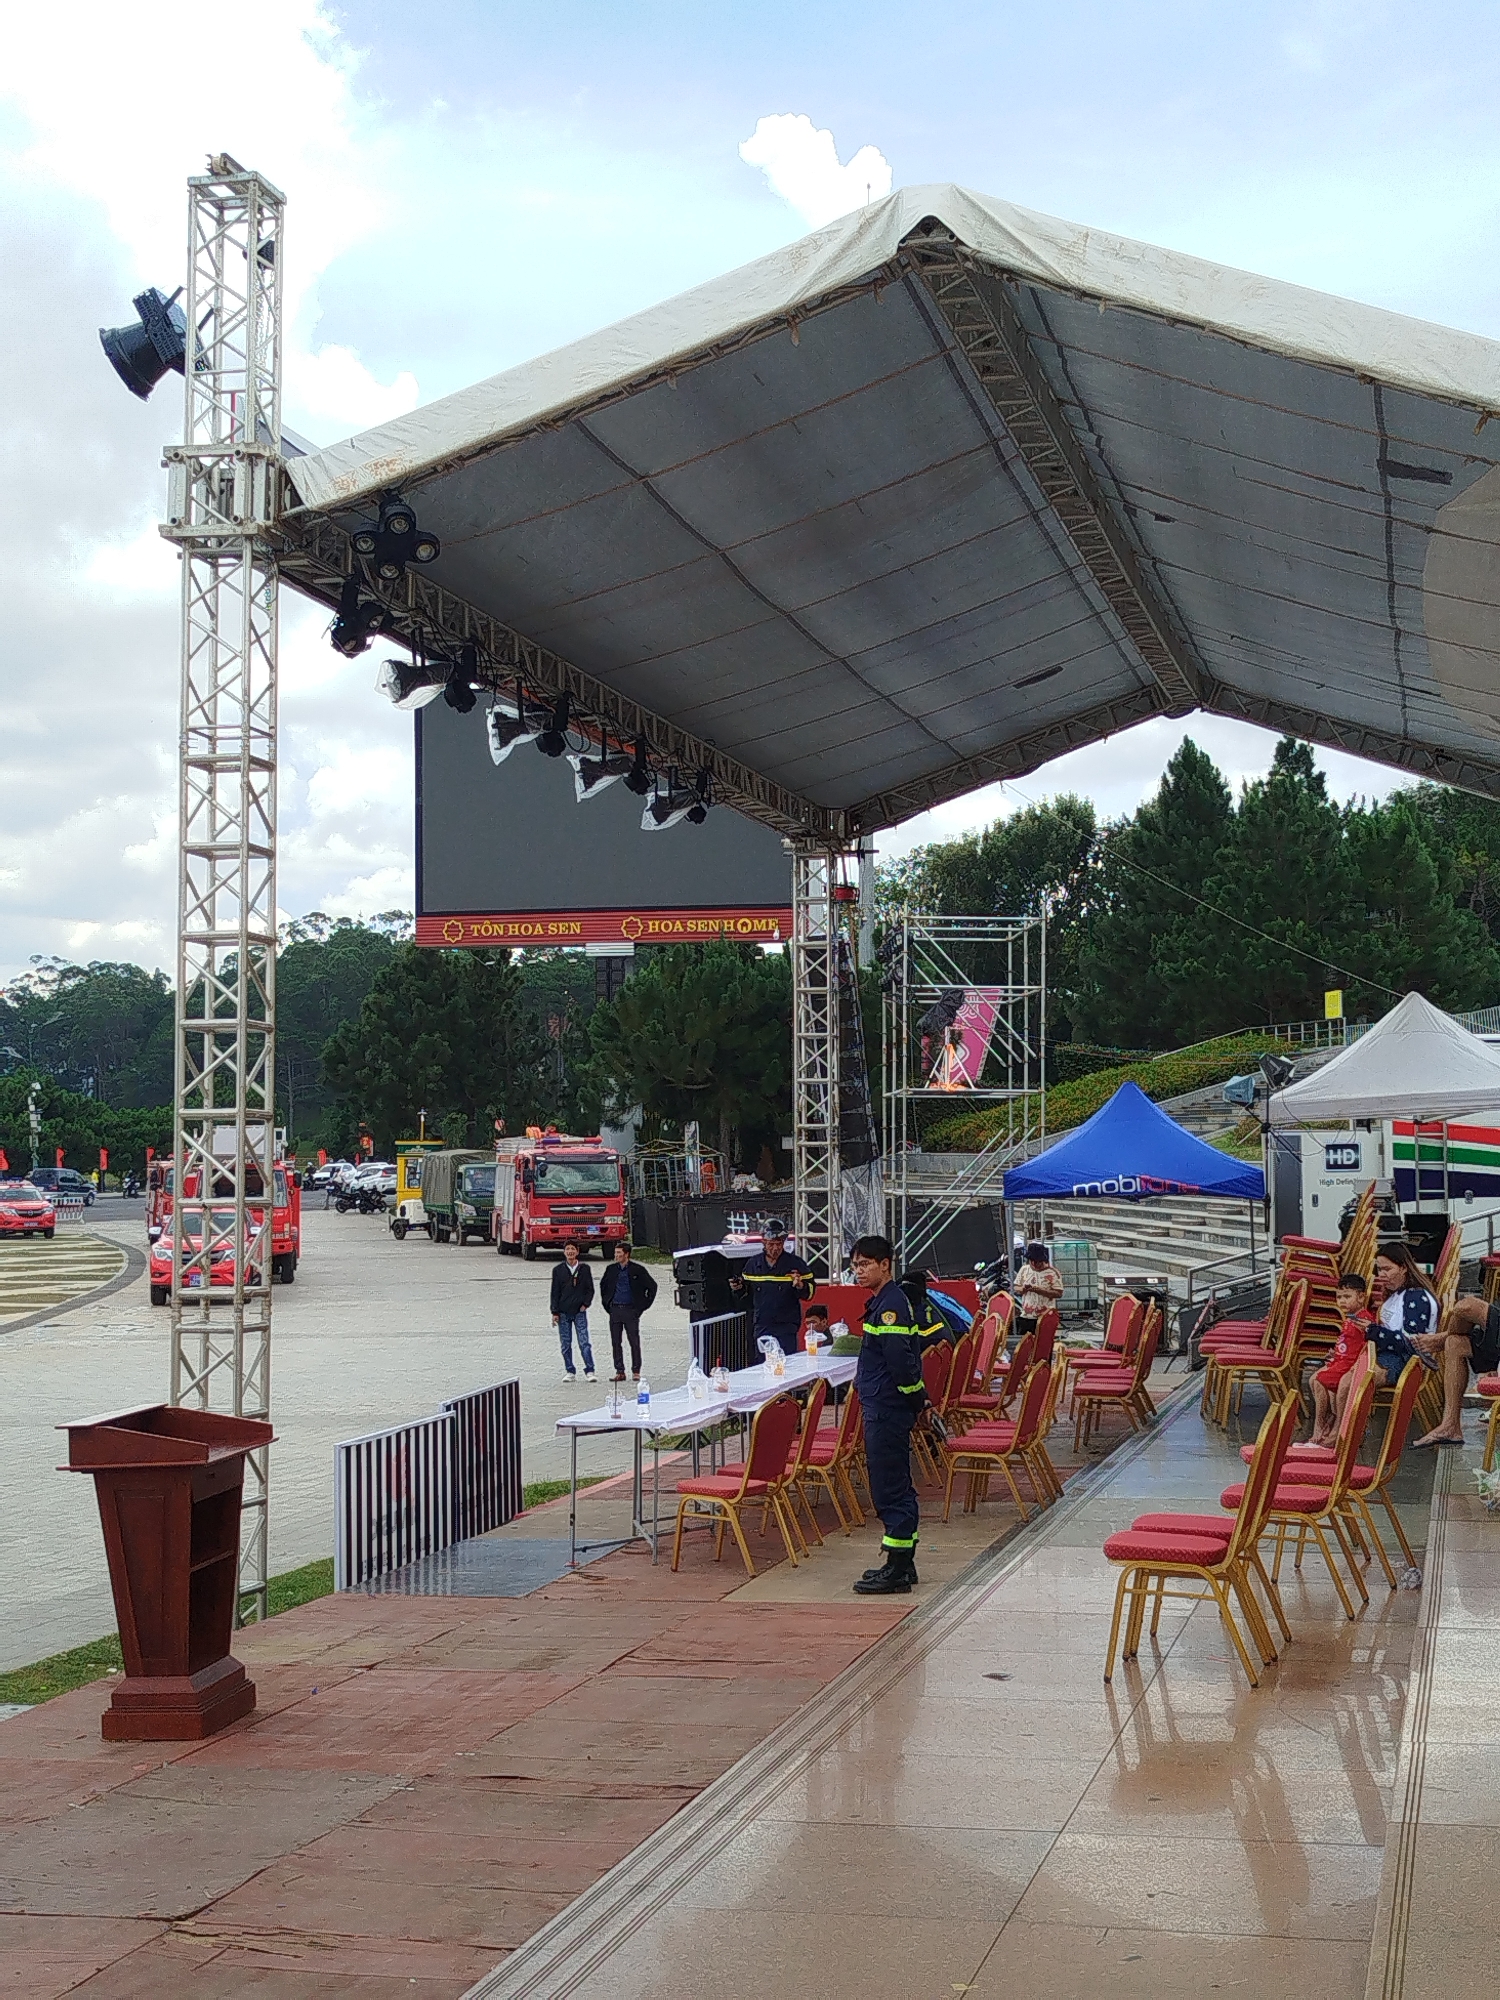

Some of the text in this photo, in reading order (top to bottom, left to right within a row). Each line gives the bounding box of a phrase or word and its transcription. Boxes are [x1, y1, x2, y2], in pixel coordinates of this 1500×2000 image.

[470, 919, 582, 937] TÔN HOA SEN
[647, 917, 779, 934] HOA SEN HOME
[1328, 1148, 1356, 1165] HD
[1319, 1178, 1335, 1187] High
